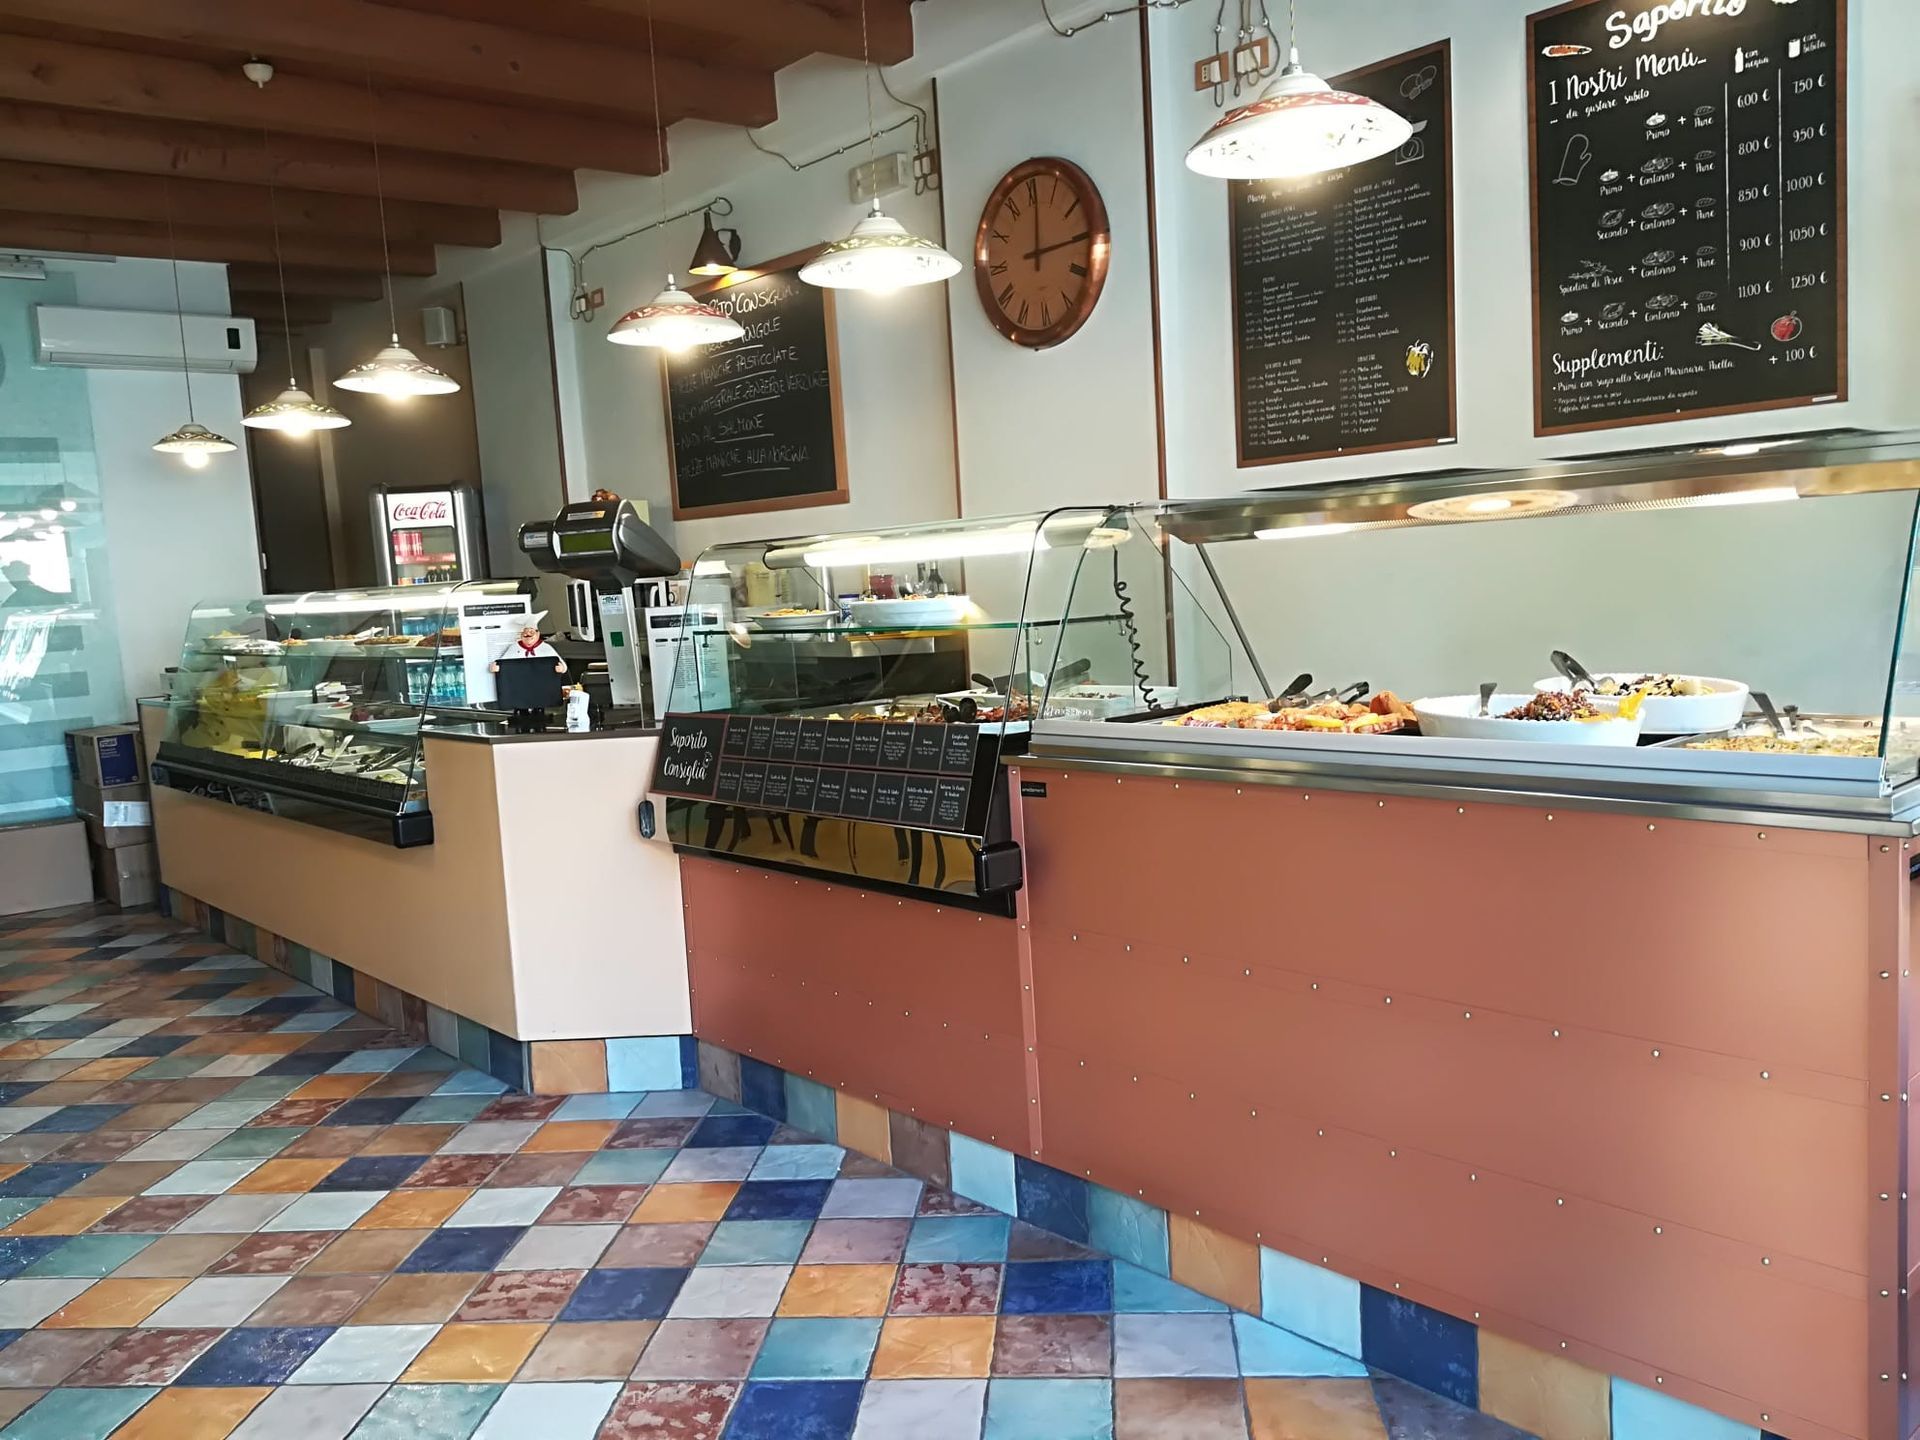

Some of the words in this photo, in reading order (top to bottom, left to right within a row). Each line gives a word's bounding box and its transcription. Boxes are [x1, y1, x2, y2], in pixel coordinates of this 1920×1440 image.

[1803, 33, 1817, 42] con
[1744, 48, 1759, 59] con
[1744, 56, 1770, 69] acqua
[1549, 80, 1559, 106] I
[1566, 66, 1628, 101] Nostri
[1817, 74, 1826, 87] €
[1566, 108, 1578, 120] da
[1585, 99, 1618, 117] gustare
[1625, 89, 1650, 104] subito
[1762, 89, 1771, 102] €
[1646, 128, 1671, 140] Primo
[1793, 129, 1814, 144] 9,50
[1819, 123, 1827, 136] €
[1738, 140, 1759, 155] 8,00
[1764, 136, 1772, 149] €
[1600, 185, 1623, 197] Primo
[1639, 171, 1675, 186] Contorno
[1786, 176, 1813, 192] 10,00
[1817, 172, 1826, 185] €
[1738, 188, 1758, 203] 8,50
[1763, 184, 1771, 197] €
[992, 229, 1010, 244] X
[1596, 227, 1628, 241] Secondo
[1640, 217, 1675, 231] Contorno
[1789, 226, 1815, 242] 10,50
[1819, 223, 1828, 236] €
[1739, 236, 1761, 251] 9,00
[1764, 234, 1773, 247] €
[1559, 281, 1589, 295] Spiedini
[1592, 281, 1600, 289] di
[1604, 275, 1624, 286] Pesce
[1640, 265, 1676, 279] Contorno
[1791, 275, 1815, 290] 12,50
[1819, 271, 1827, 284] €
[1738, 284, 1761, 299] 11,00
[1764, 281, 1773, 294] €
[1560, 325, 1583, 336] Primo
[1598, 317, 1628, 330] Secondo
[1644, 309, 1680, 322] Contorno
[1552, 340, 1664, 379] Supplementi:
[1808, 346, 1818, 359] €
[1558, 382, 1577, 391] Primi
[1580, 380, 1593, 389] con
[1597, 377, 1614, 388] sugo
[1616, 373, 1632, 384] allo
[670, 726, 708, 754] Saporito
[663, 755, 708, 786] Consiglia
